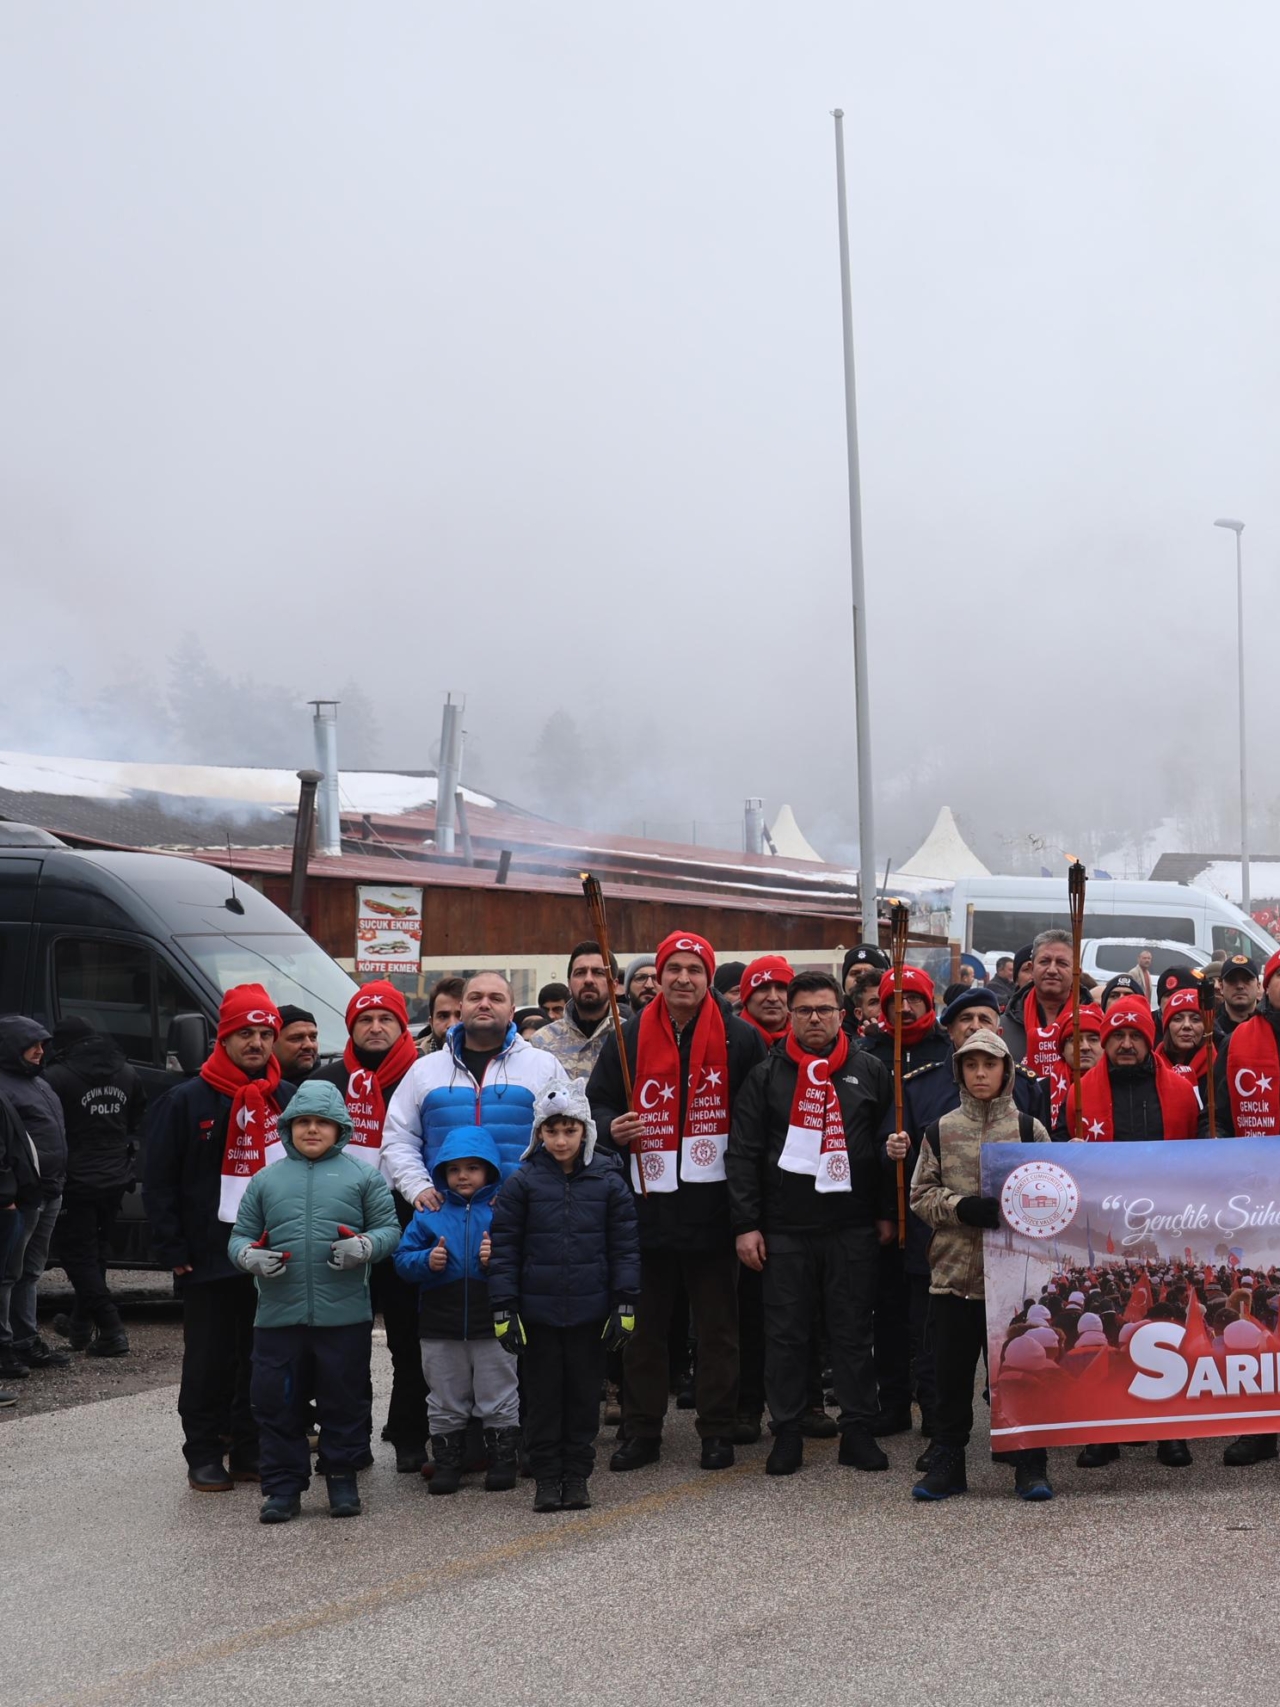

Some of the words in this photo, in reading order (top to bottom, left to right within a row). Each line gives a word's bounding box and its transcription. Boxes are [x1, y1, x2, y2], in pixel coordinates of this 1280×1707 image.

[360, 920, 388, 930] SUCUK
[391, 921, 420, 930] EKMEK
[358, 961, 386, 972] KÖFTE
[388, 962, 418, 973] EKMEK
[1240, 1100, 1269, 1113] GENÇLİK
[1236, 1115, 1275, 1129] ŞÜHEDANIN
[690, 1123, 718, 1134] İZİNDE
